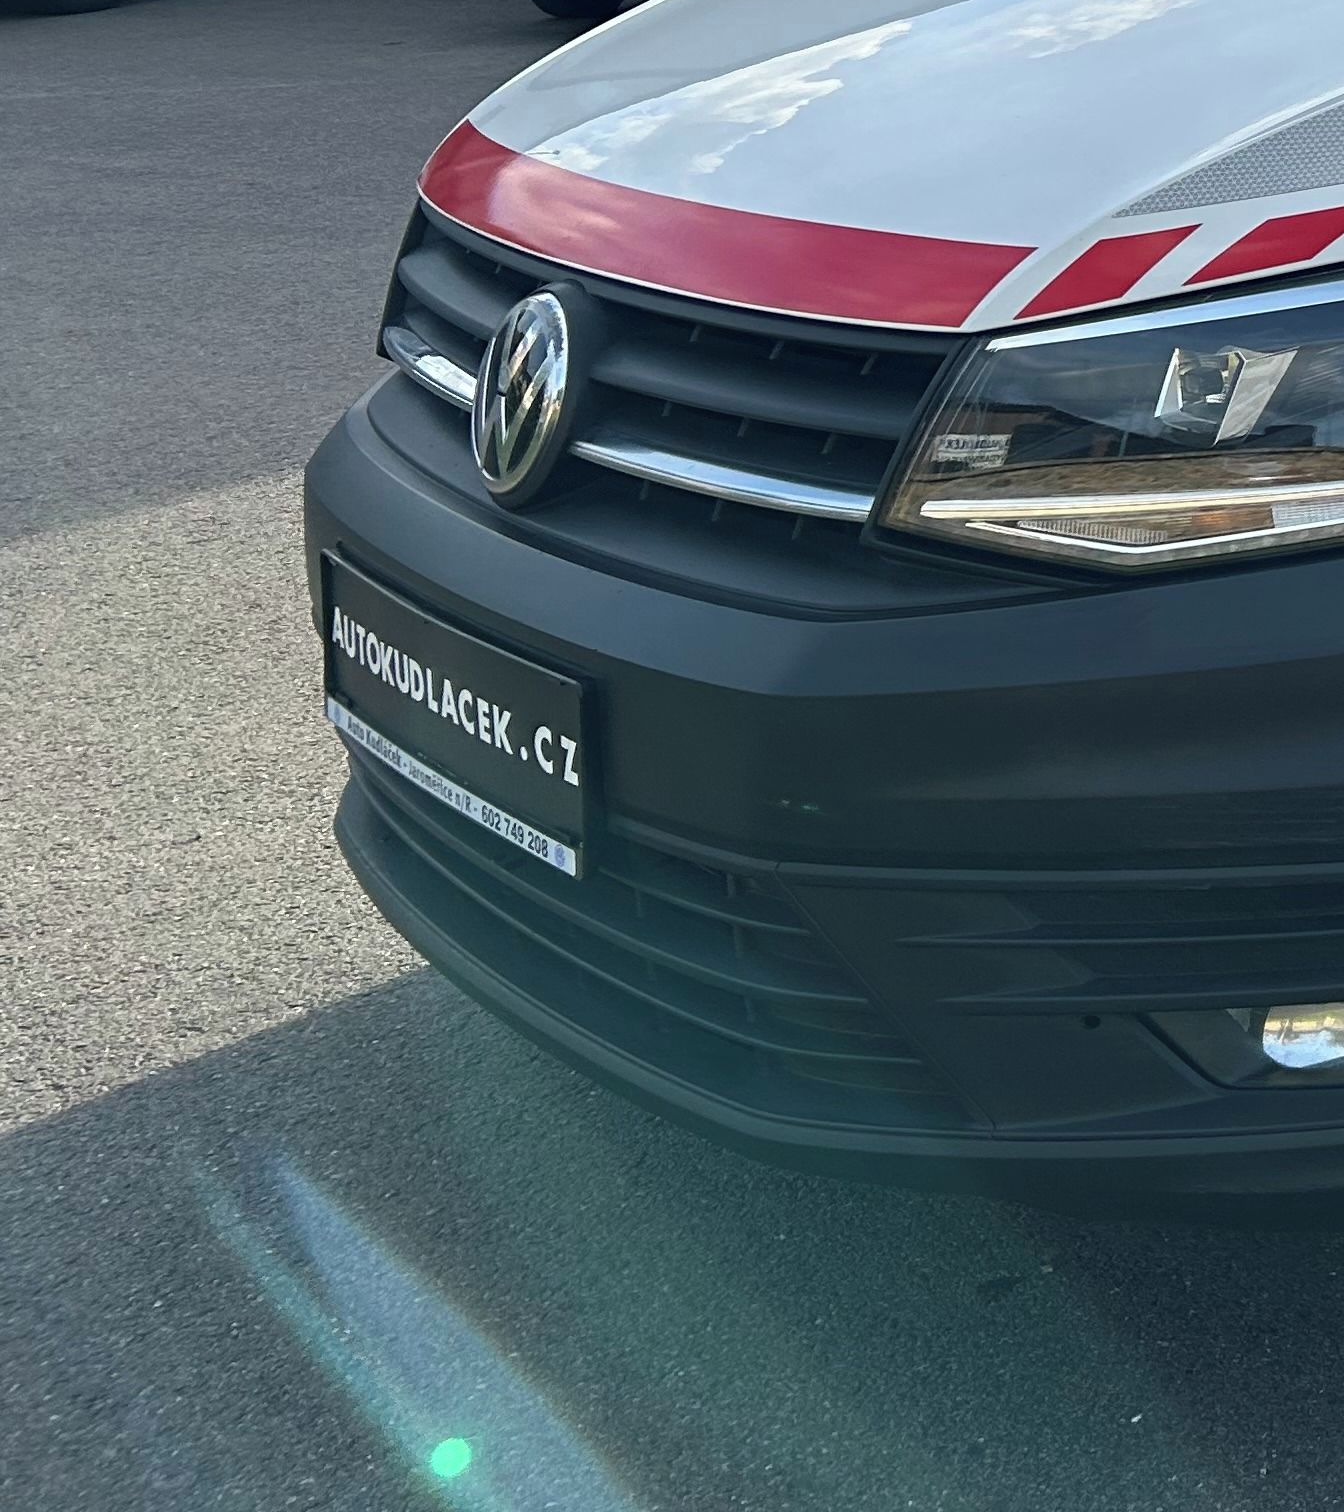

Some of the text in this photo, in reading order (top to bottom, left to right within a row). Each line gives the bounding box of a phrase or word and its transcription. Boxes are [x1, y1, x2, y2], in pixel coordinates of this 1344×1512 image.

[332, 605, 580, 787] AUTOKUDLACEK.CZ
[347, 715, 365, 741] Auto
[481, 804, 502, 832] 602
[503, 816, 525, 845] 749
[527, 830, 549, 858] 208
